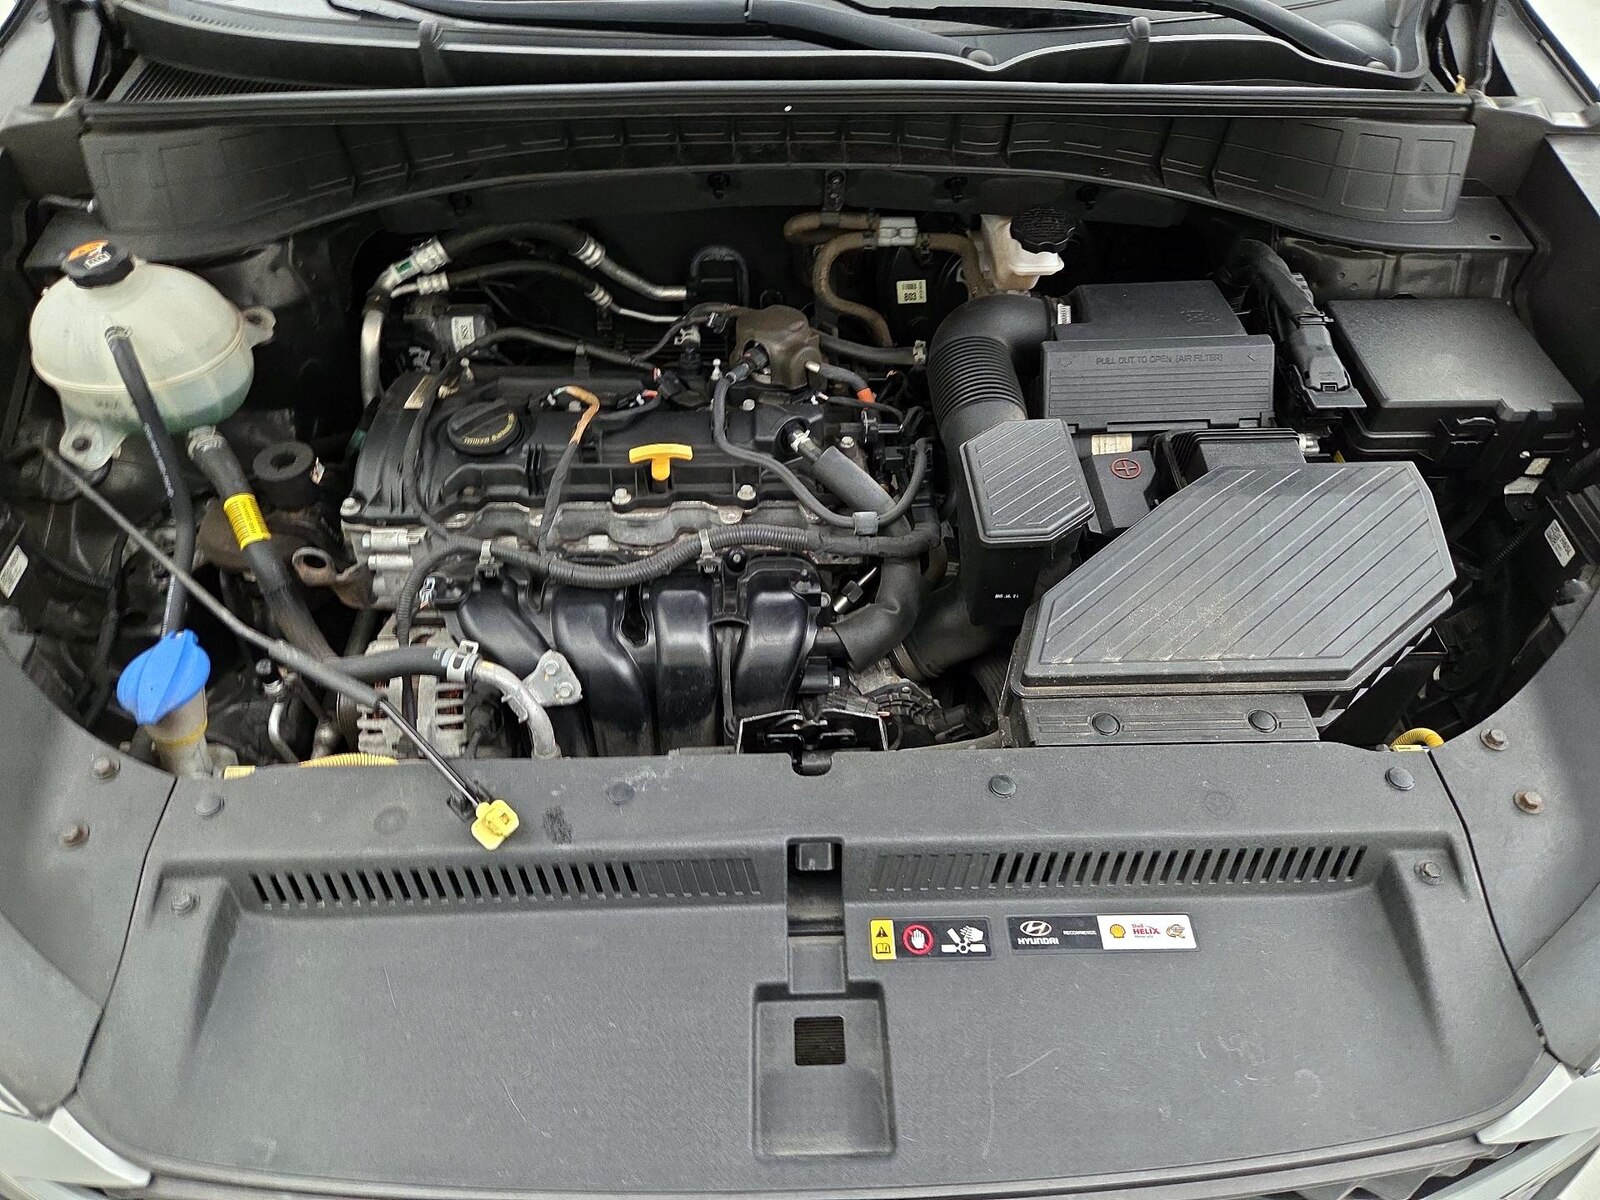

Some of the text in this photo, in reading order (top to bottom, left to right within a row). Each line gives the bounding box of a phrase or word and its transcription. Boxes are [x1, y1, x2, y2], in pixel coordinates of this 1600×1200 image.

[1096, 357, 1117, 365] PULL
[1119, 356, 1135, 365] OUT
[1136, 355, 1148, 364] TO
[1149, 354, 1172, 363] OPEN
[1017, 937, 1059, 945] HYUNDAI
